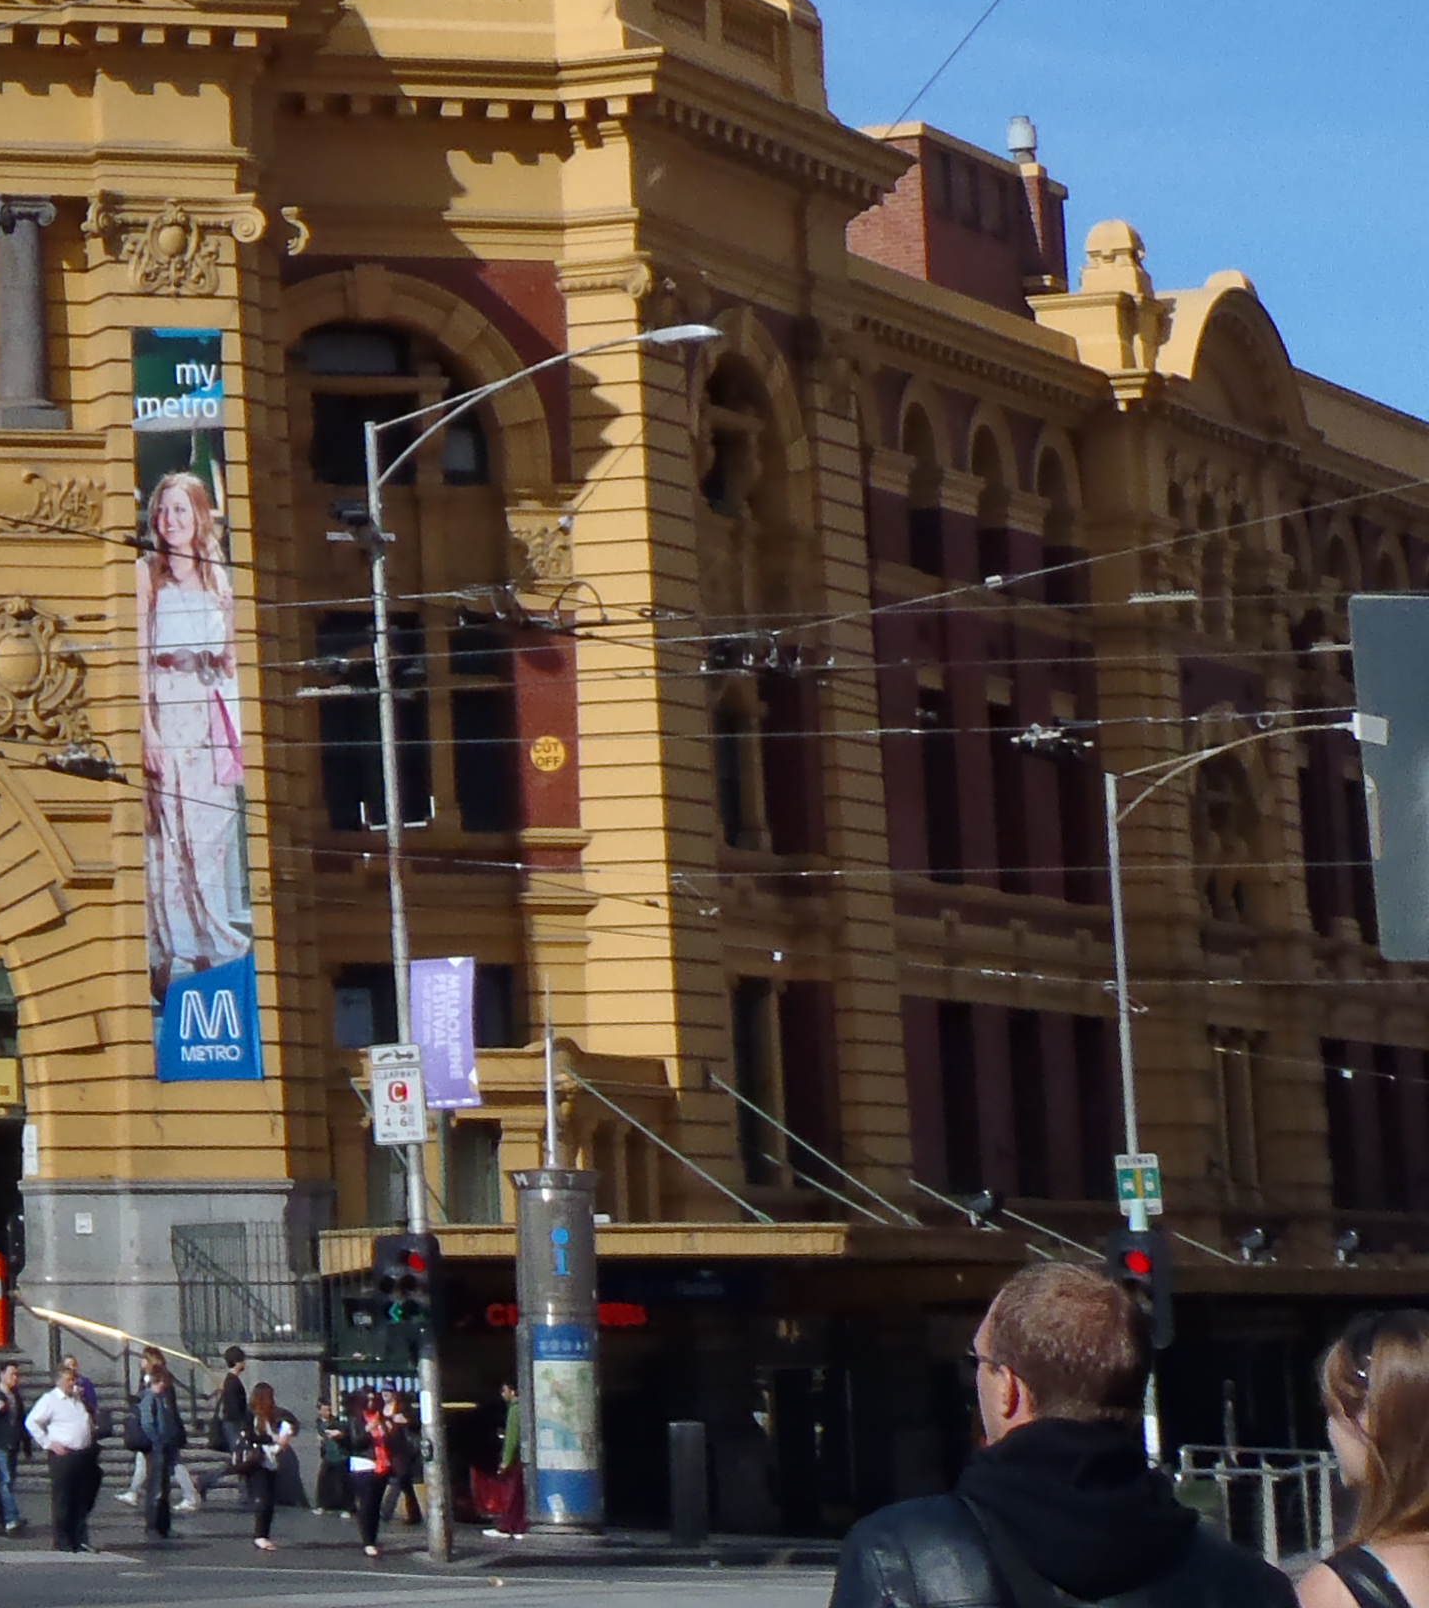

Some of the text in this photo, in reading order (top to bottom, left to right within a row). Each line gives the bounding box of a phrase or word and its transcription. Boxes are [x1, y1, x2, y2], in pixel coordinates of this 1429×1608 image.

[175, 362, 217, 391] my
[135, 393, 218, 419] metro
[533, 742, 559, 753] CUT
[536, 756, 561, 767] OFF
[433, 974, 446, 1050] FESTIVAL
[446, 974, 464, 1080] MELBOURNE
[181, 1044, 241, 1061] METRO
